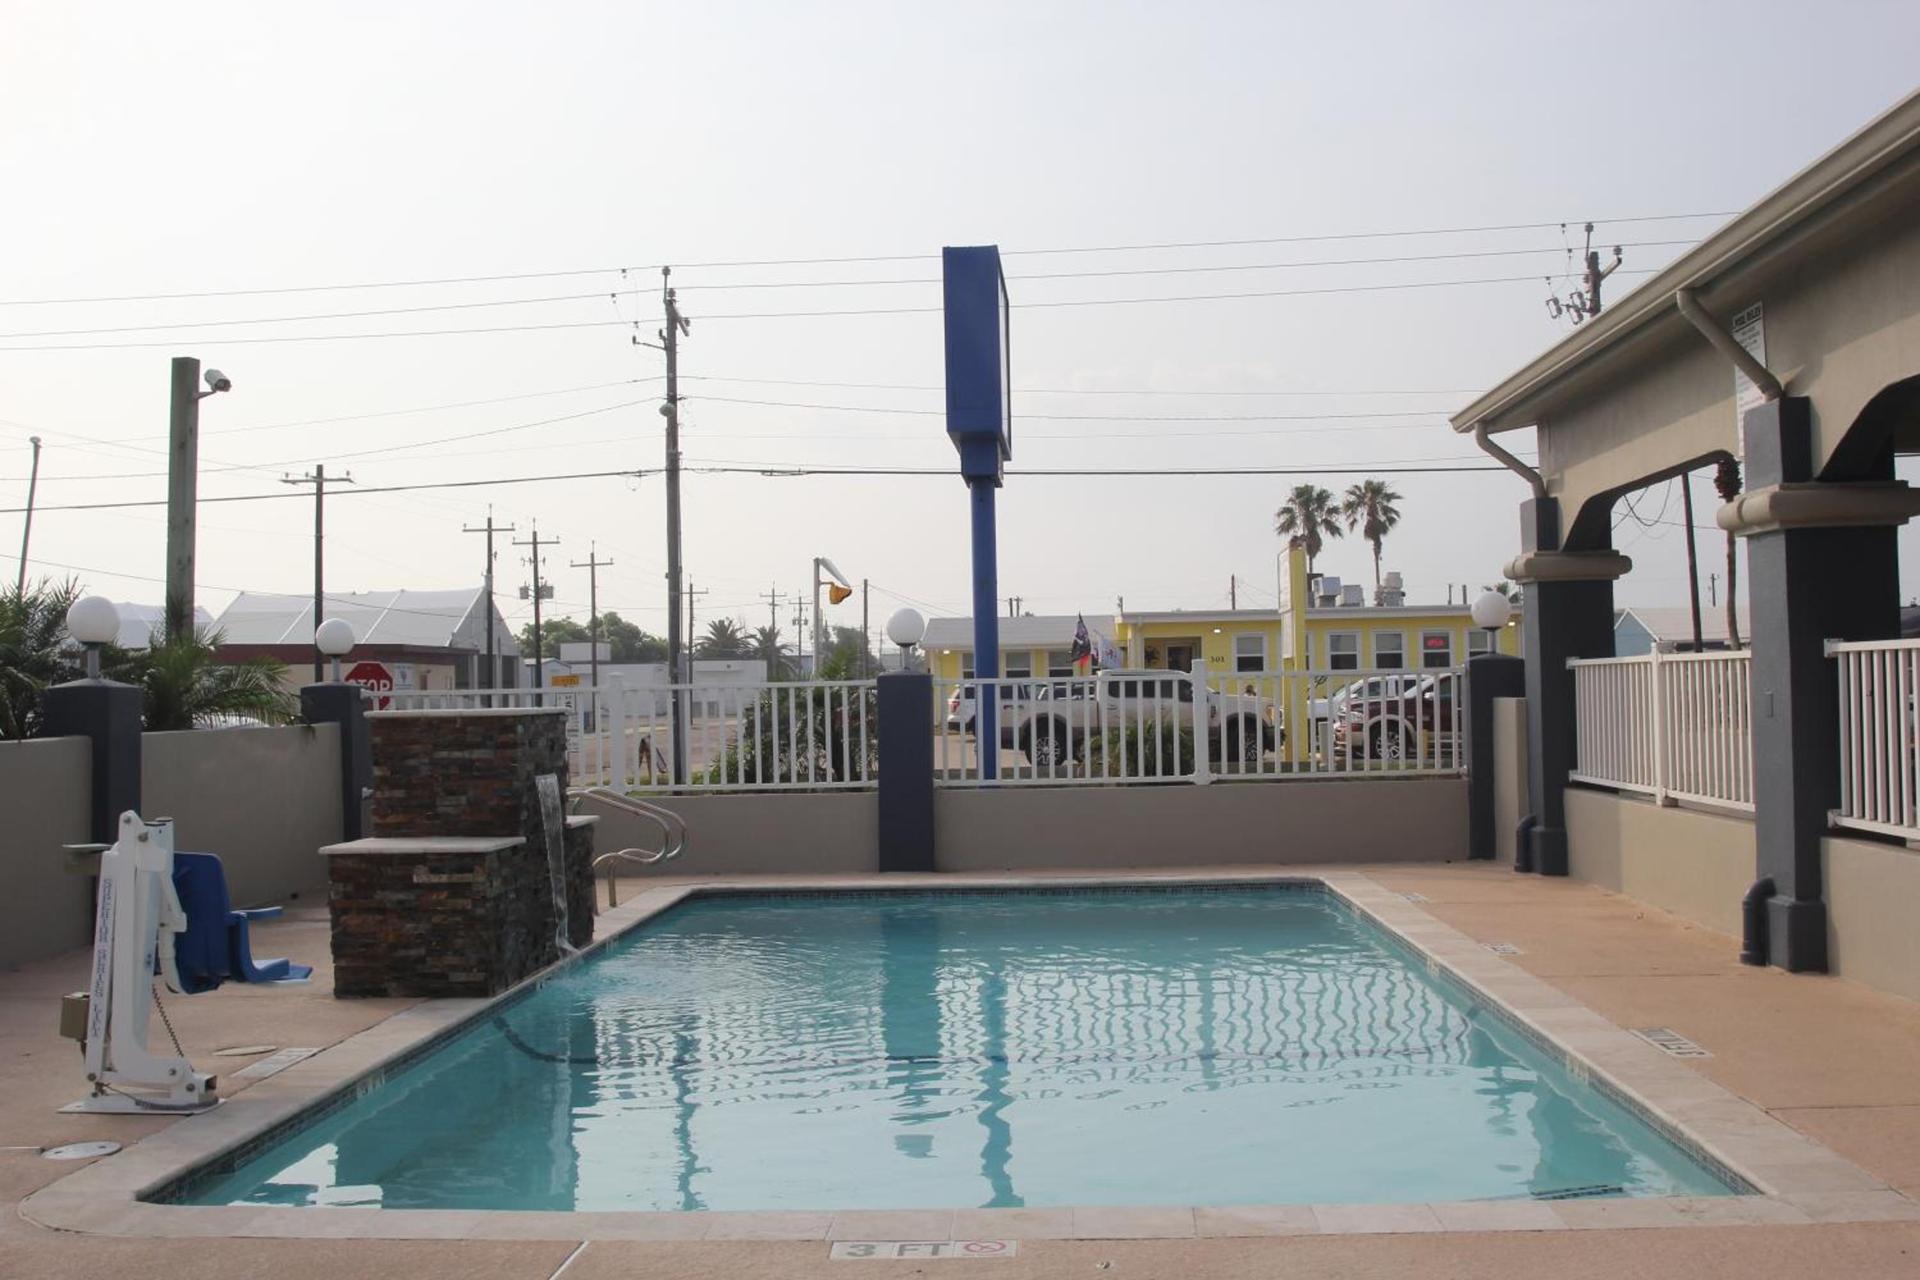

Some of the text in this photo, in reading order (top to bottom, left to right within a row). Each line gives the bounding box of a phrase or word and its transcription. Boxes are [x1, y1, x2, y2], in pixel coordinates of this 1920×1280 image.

[347, 679, 391, 695] OP
[846, 1242, 950, 1257] 3 FT
